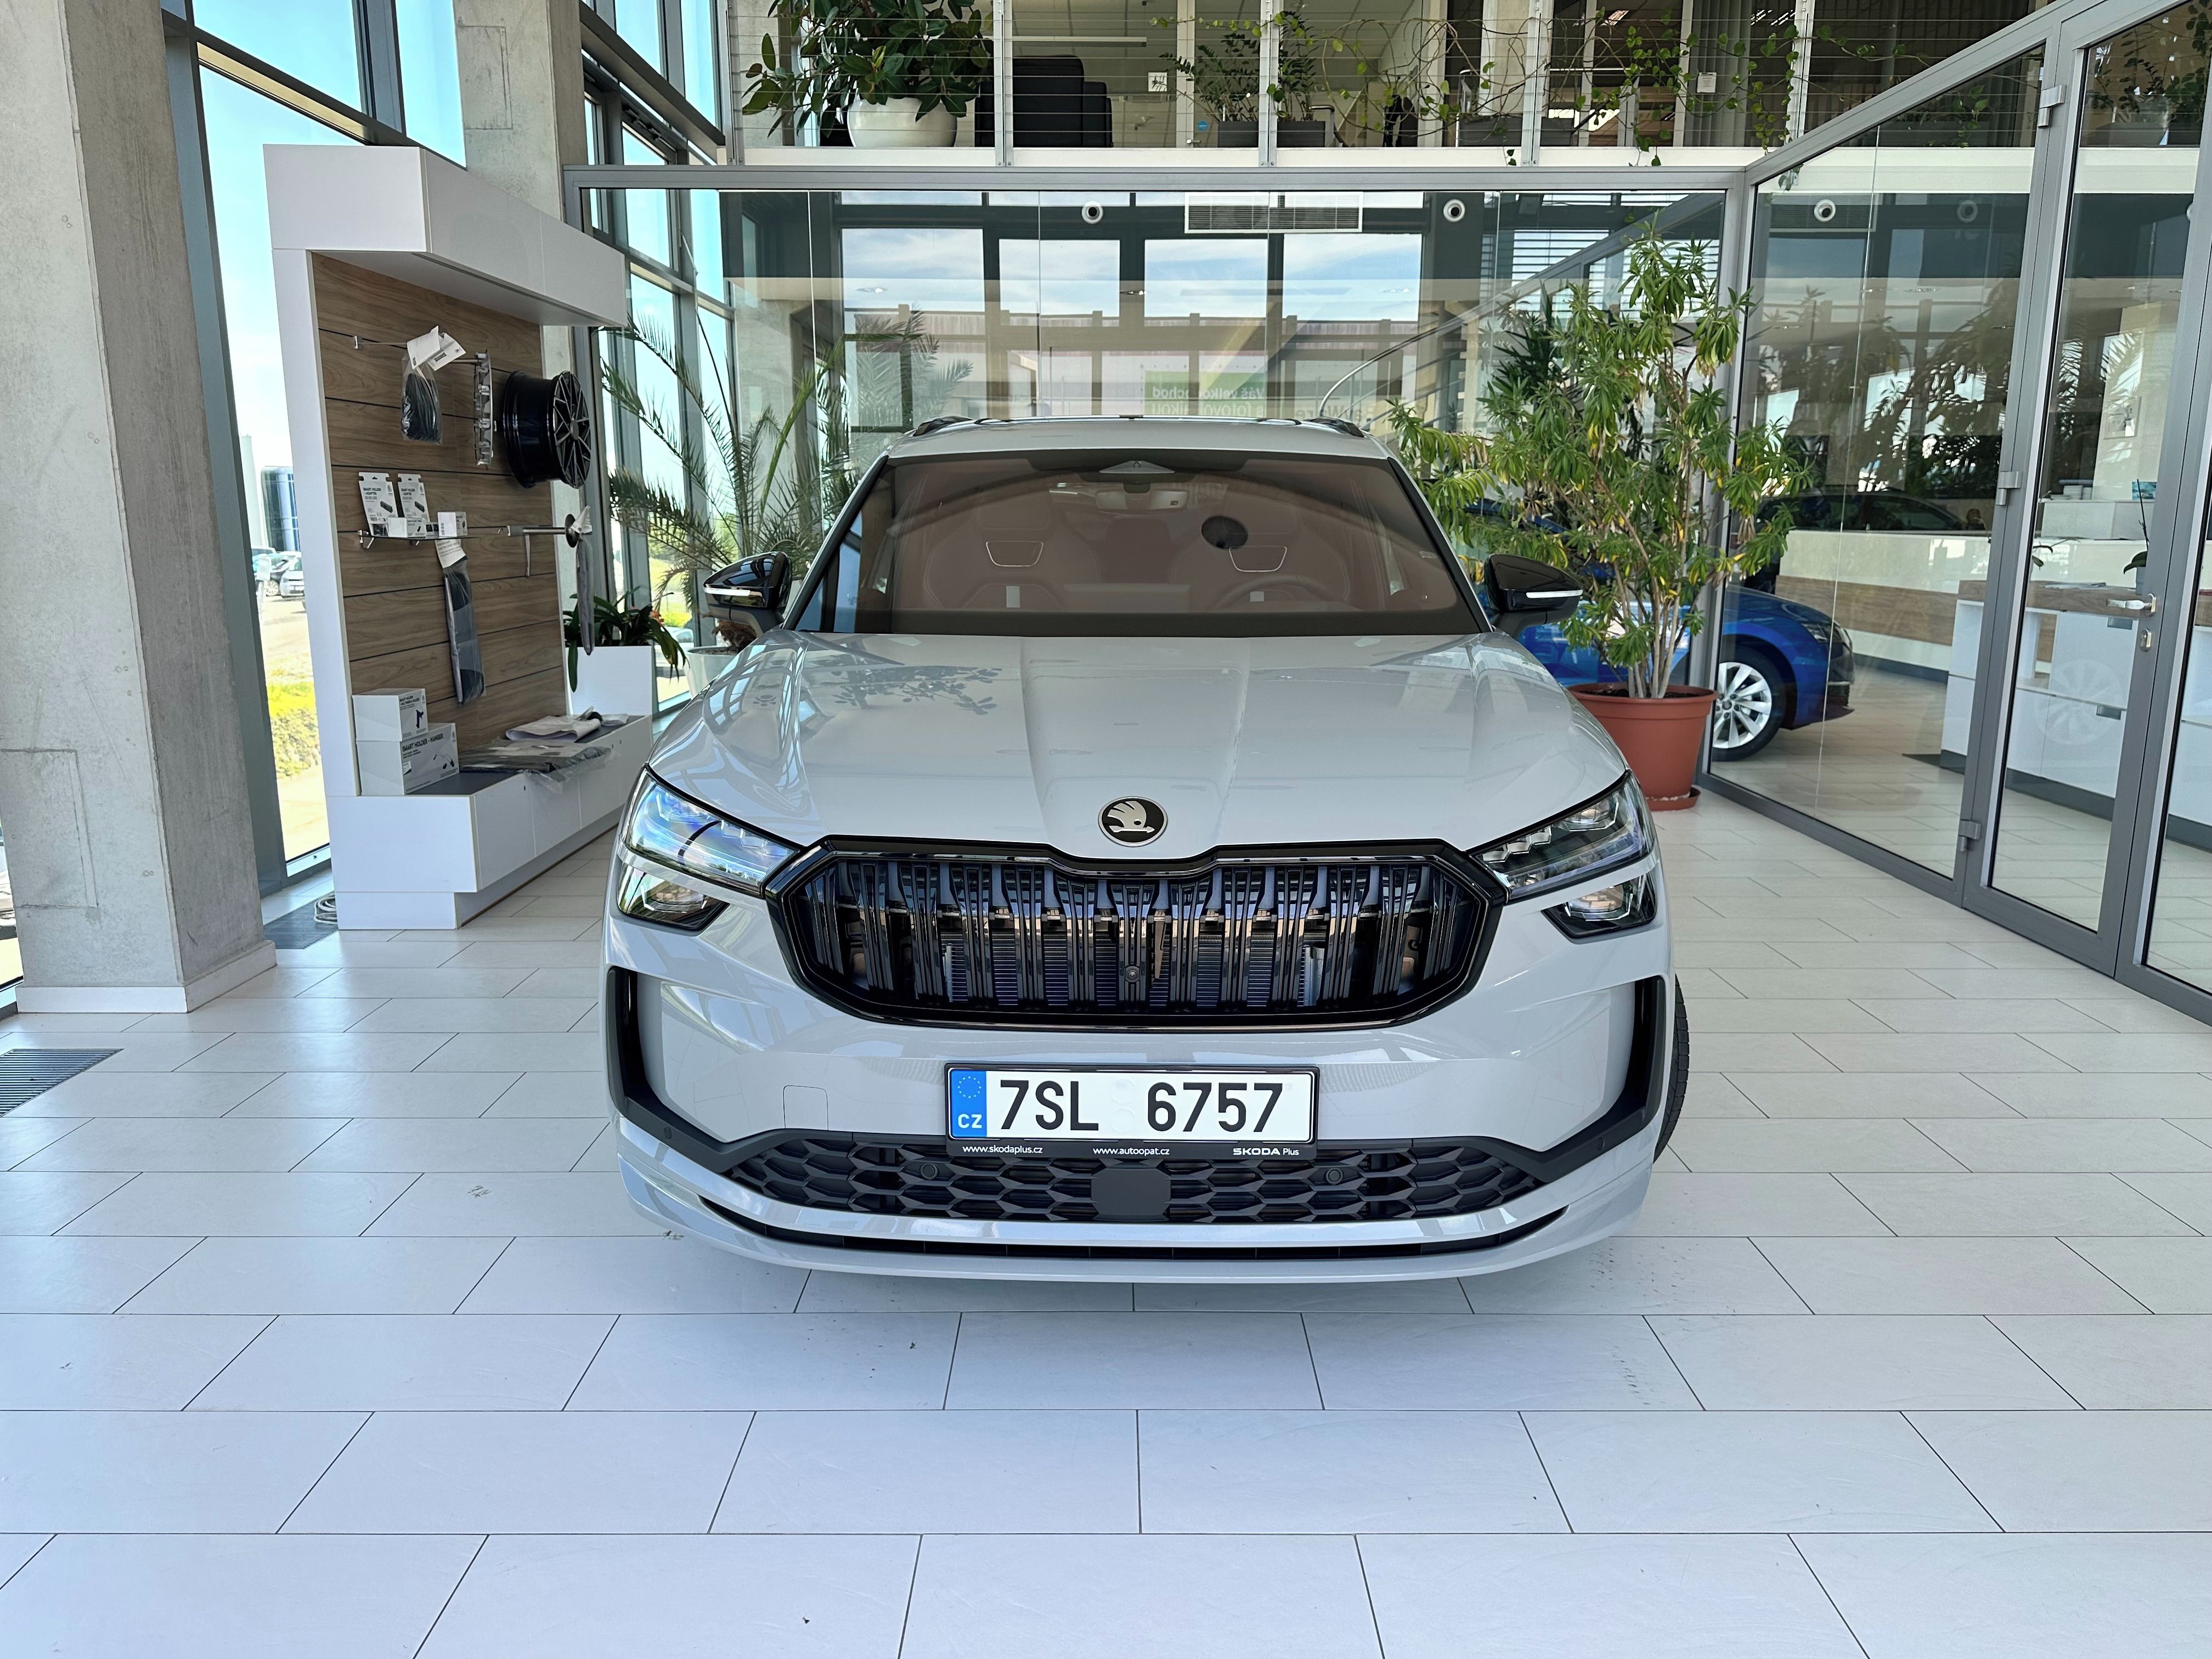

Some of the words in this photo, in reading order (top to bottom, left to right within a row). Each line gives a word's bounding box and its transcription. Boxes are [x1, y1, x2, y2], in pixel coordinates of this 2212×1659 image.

[402, 743, 414, 752] SMART
[415, 738, 428, 748] HOLDER
[1000, 1079, 1099, 1131] 7SL
[1147, 1082, 1283, 1132] 6757
[958, 1113, 983, 1128] CZ
[962, 1144, 1043, 1155] www.skodaplus.cz
[1093, 1147, 1170, 1156] www.autoopat.cz
[1283, 1148, 1300, 1156] Plus
